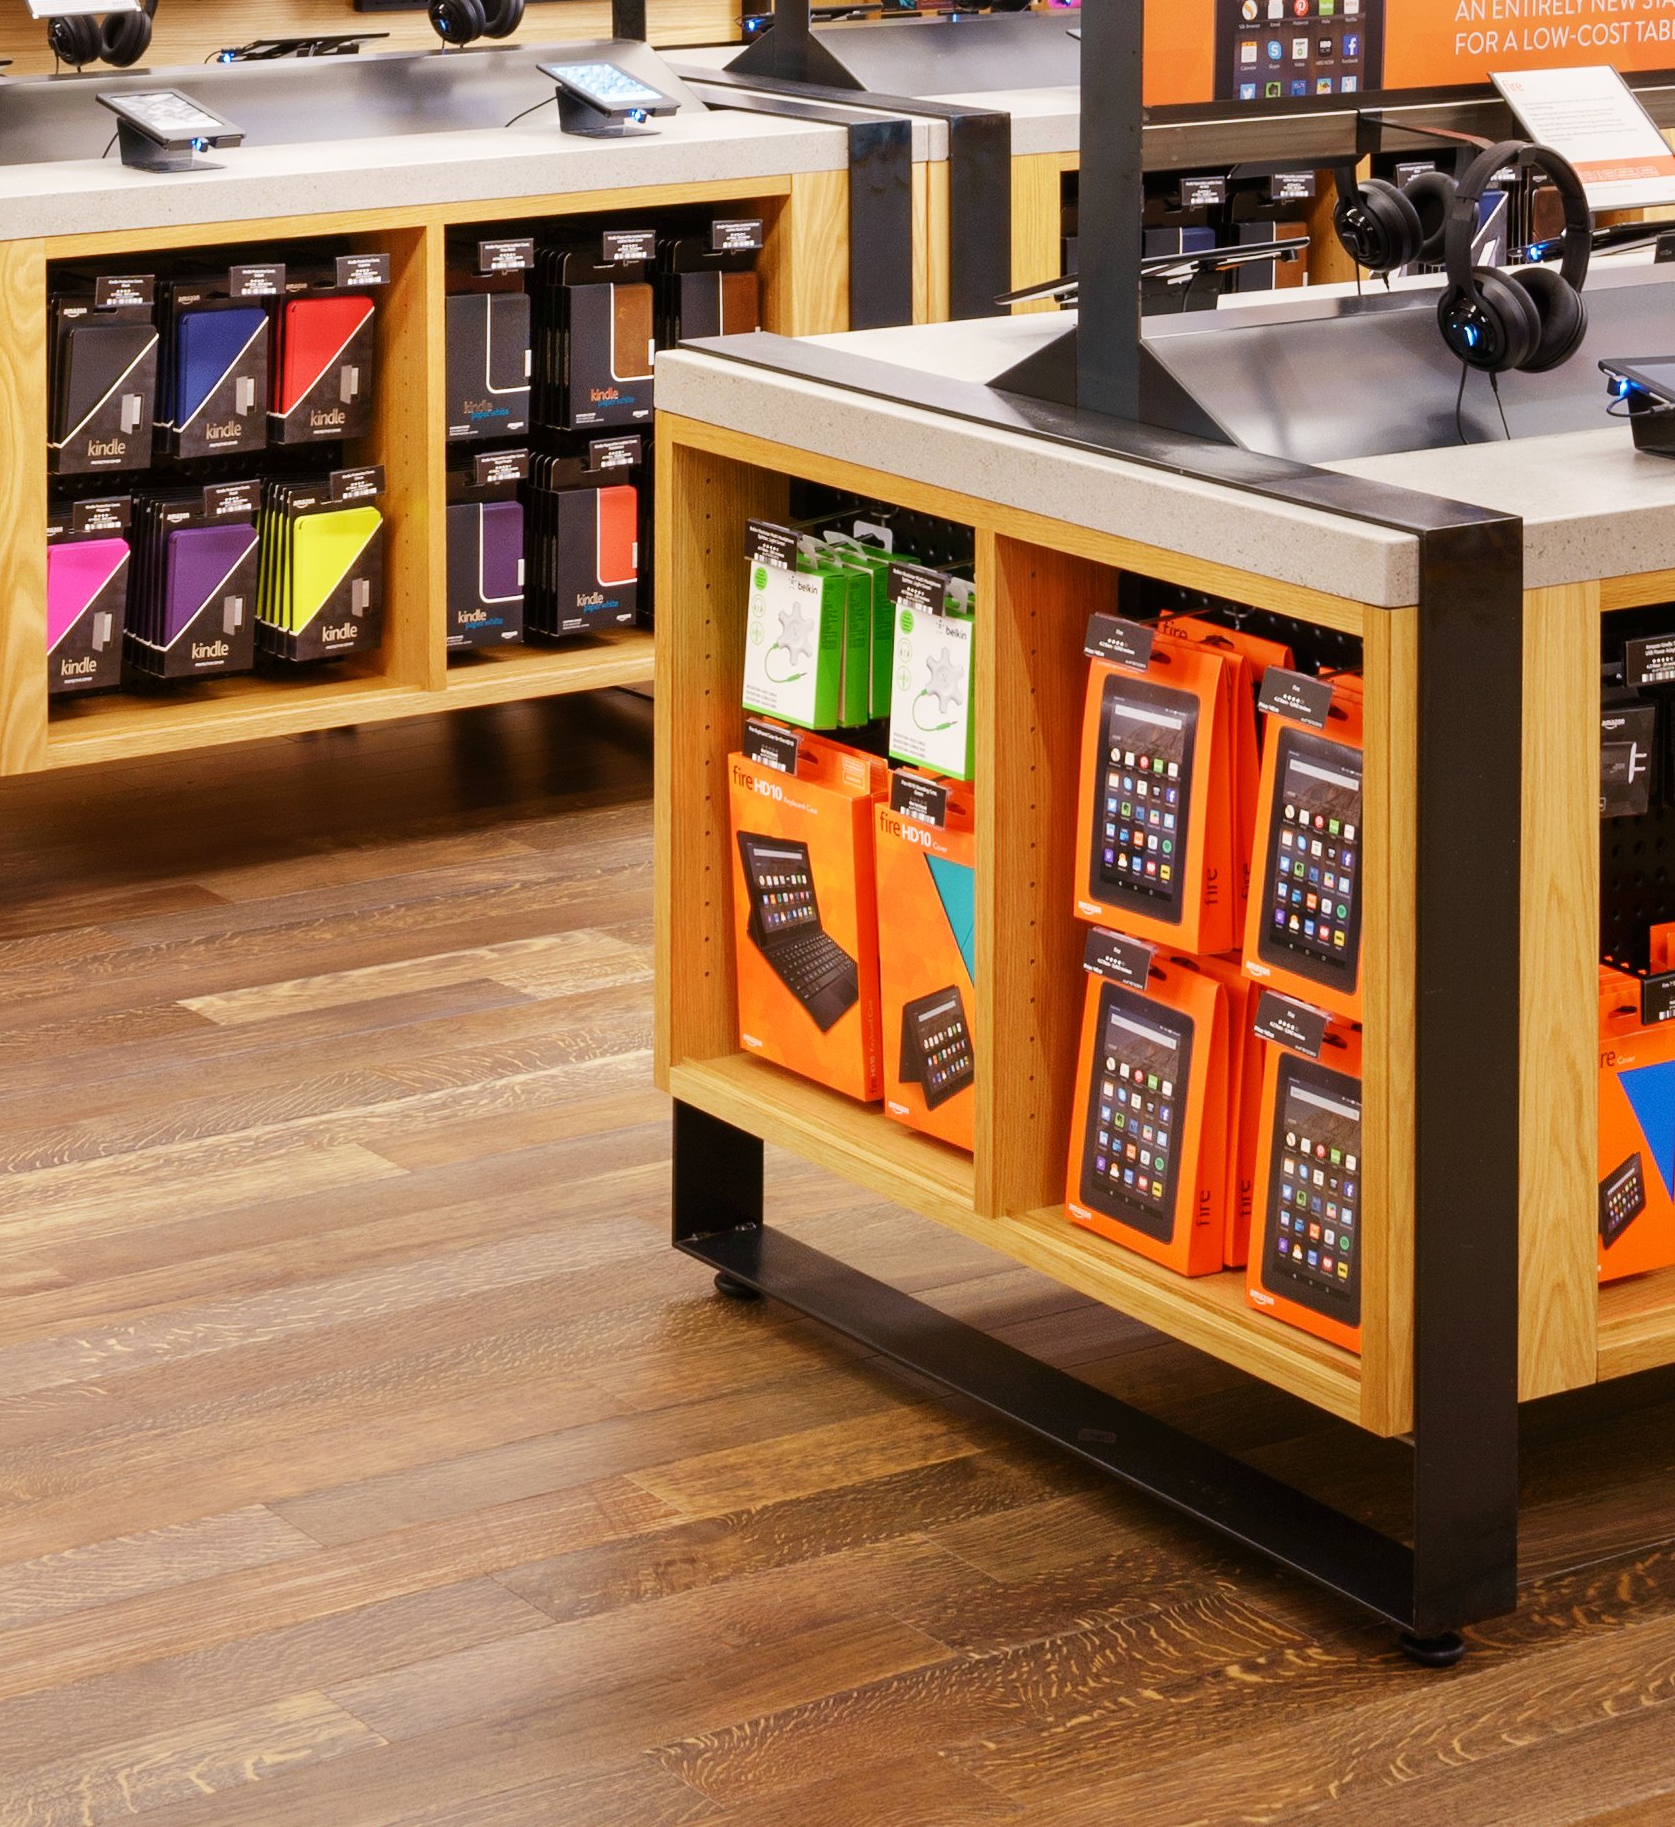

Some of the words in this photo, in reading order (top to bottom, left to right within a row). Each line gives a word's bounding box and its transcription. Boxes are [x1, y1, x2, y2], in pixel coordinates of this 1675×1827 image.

[1454, 0, 1486, 21] AN
[1454, 32, 1497, 56] FOR
[1503, 30, 1518, 51] A
[1523, 23, 1635, 50] LOW-COST
[311, 410, 345, 427] kindle
[88, 439, 126, 457] kindle
[797, 580, 818, 594] belkin
[733, 765, 753, 790] fire
[754, 780, 783, 802] HD10
